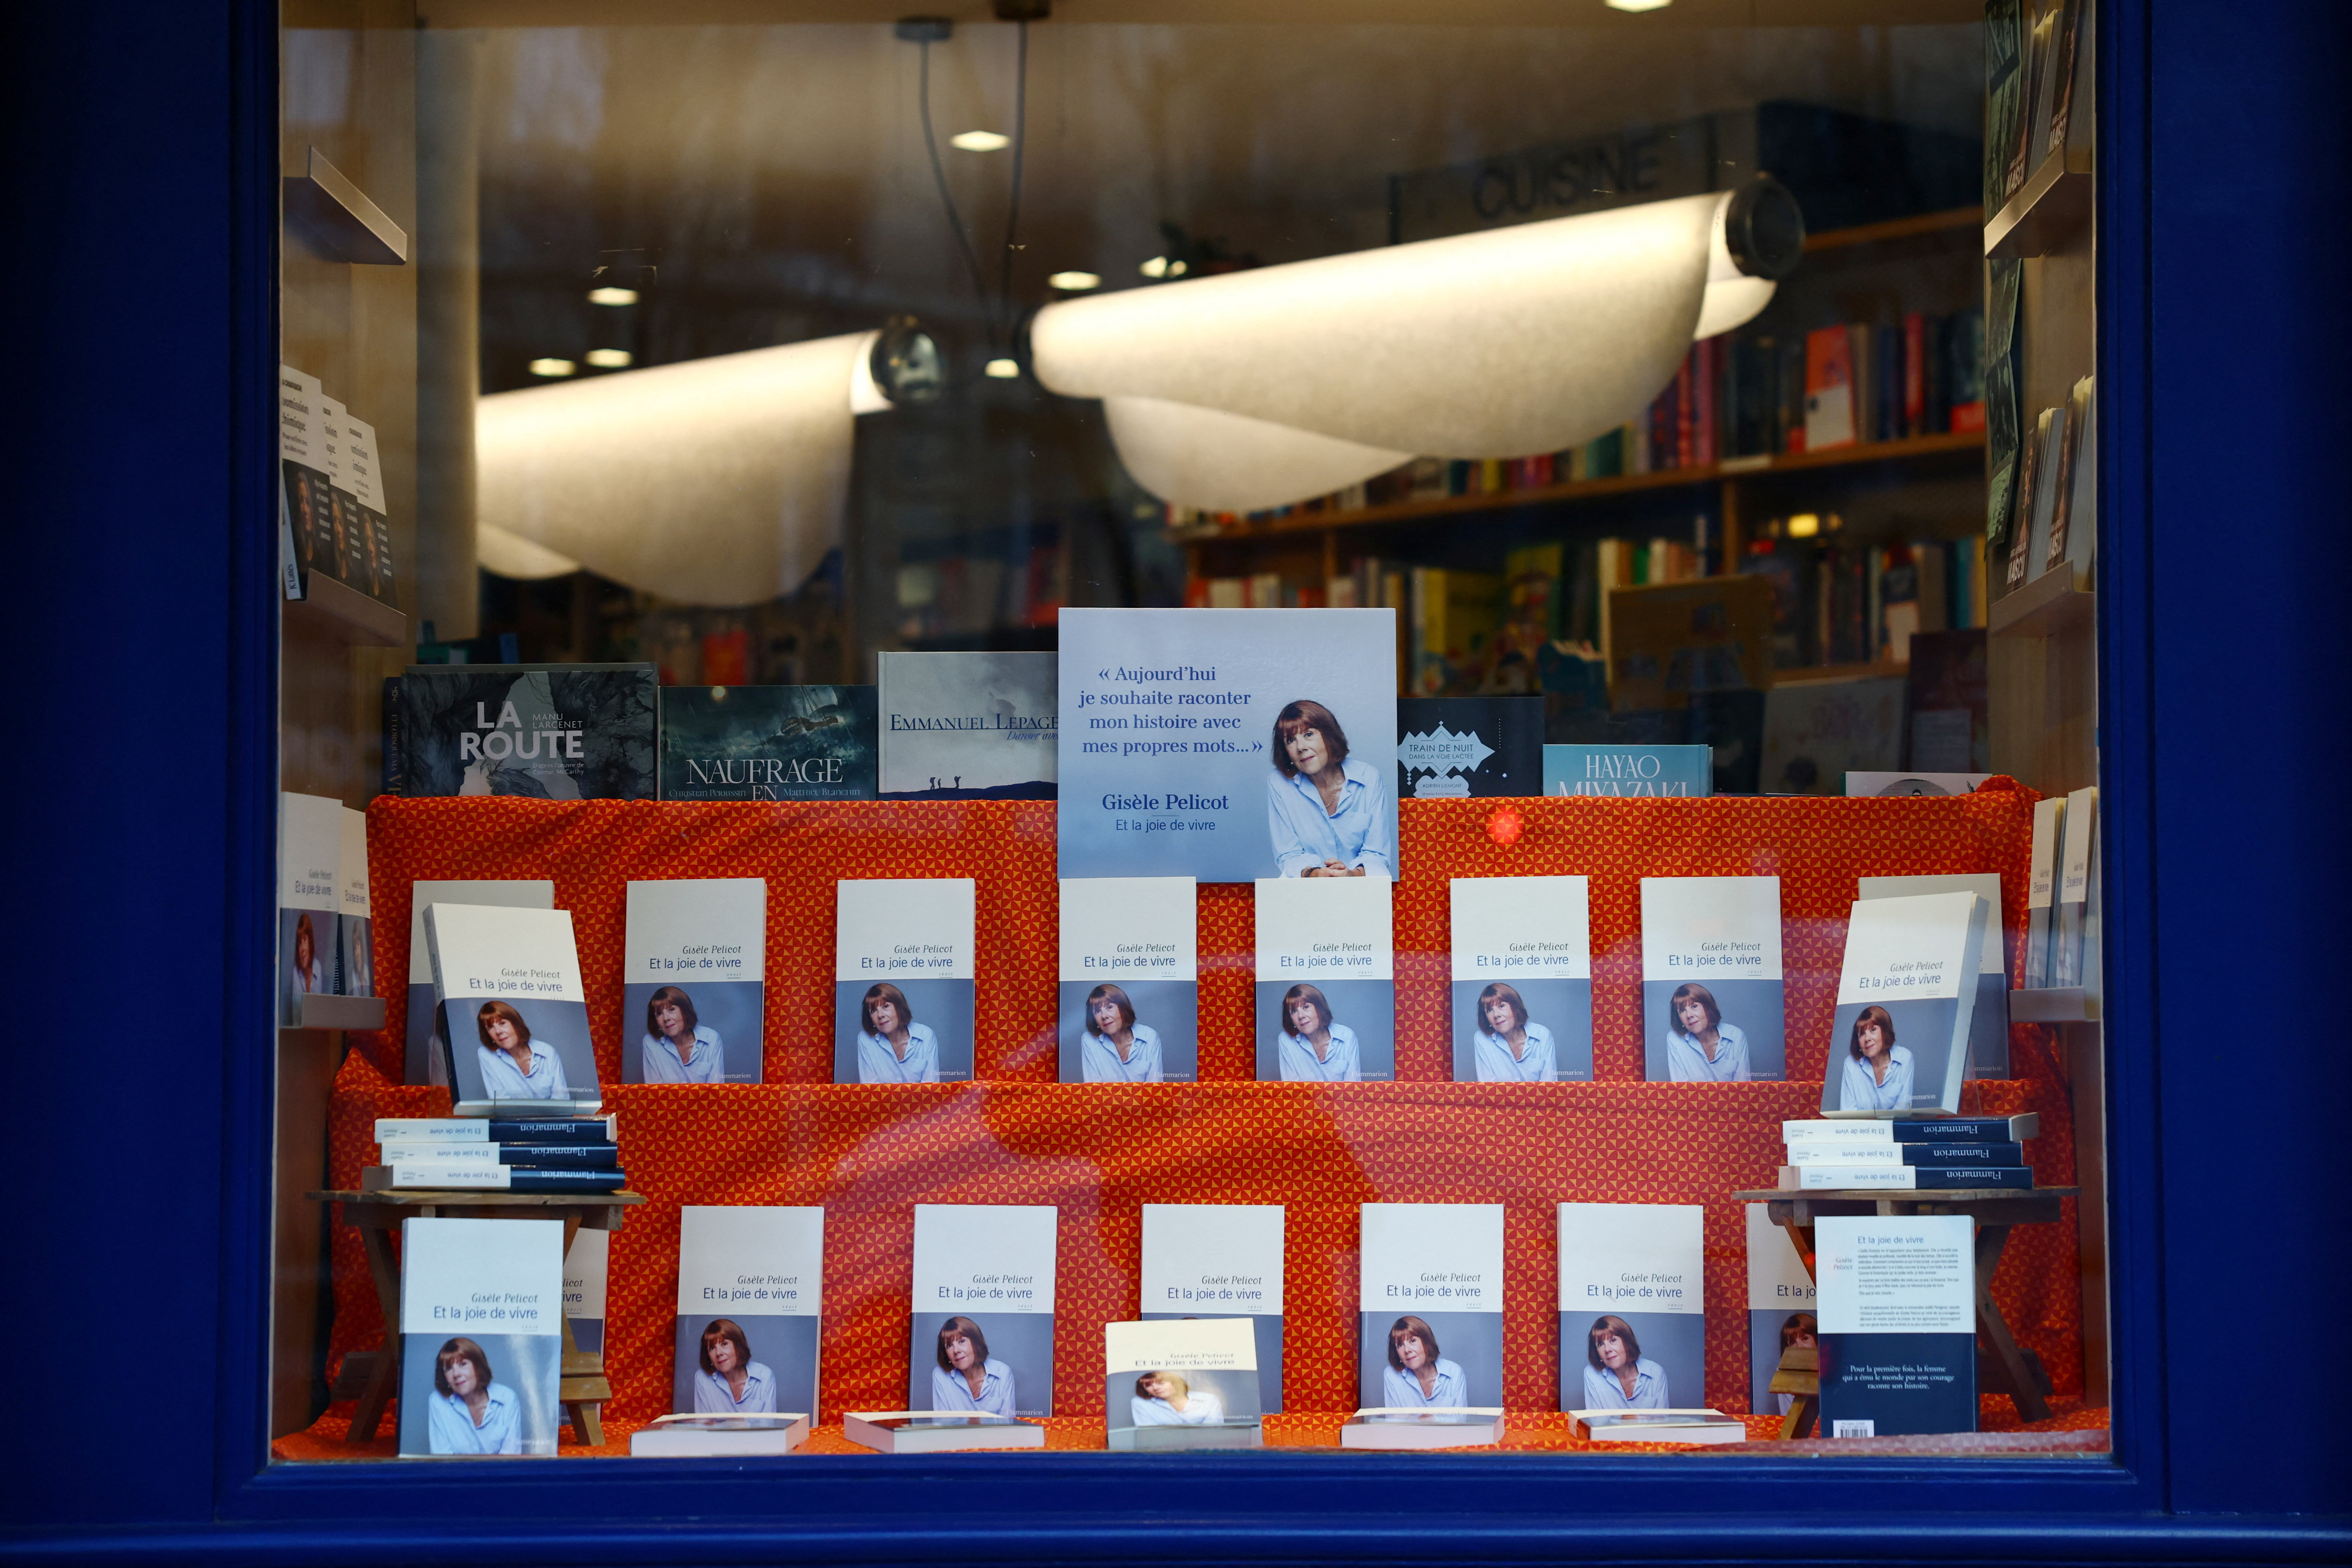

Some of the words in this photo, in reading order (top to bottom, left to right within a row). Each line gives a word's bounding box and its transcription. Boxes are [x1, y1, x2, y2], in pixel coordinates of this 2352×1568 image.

[1114, 666, 1216, 684] Aujourd’hui
[1078, 690, 1095, 708] je
[1100, 690, 1173, 705] souhaite
[1178, 691, 1251, 705] raconter
[477, 700, 523, 728] LA
[891, 714, 989, 729] EMMANUEL
[996, 712, 1058, 729] LEPAGE
[533, 721, 583, 729] LARCENET
[1090, 718, 1129, 729] mon
[1133, 714, 1197, 728] histoire
[1203, 718, 1241, 728] avec
[1006, 731, 1041, 741] Danser
[461, 730, 584, 760] ROUTE
[1083, 742, 1118, 753] mes
[1123, 742, 1188, 756] propres
[686, 758, 843, 784] NAUFRAGE
[1586, 755, 1660, 778] HAYAO
[752, 785, 778, 801] EN
[1102, 794, 1159, 810] Gisèle
[1165, 794, 1229, 810] Pelicot
[1116, 819, 1128, 831] Et
[1132, 819, 1141, 831] la
[1145, 819, 1166, 833] joie
[1170, 819, 1184, 831] de
[1188, 819, 1216, 831] vivre
[682, 945, 709, 954] Gisèle
[711, 945, 742, 954] Pelicot
[894, 945, 920, 954] Gisèle
[923, 945, 953, 953] Pelicot
[1117, 944, 1143, 952] Gisèle
[1146, 943, 1176, 952] Pelicot
[1510, 943, 1535, 952] Gisèle
[1538, 943, 1568, 951] Pelicot
[1701, 943, 1728, 951] Gisèle
[1731, 942, 1761, 951] Pelicot
[650, 958, 661, 969] Et
[664, 958, 673, 968] la
[676, 957, 696, 971] joie
[699, 957, 713, 968] de
[716, 957, 741, 968] vivre
[862, 957, 873, 968] Et
[876, 957, 885, 968] la
[888, 957, 908, 970] joie
[911, 957, 924, 967] de
[928, 957, 953, 967] vivre
[1085, 957, 1096, 967] Et
[1099, 956, 1108, 967] la
[1111, 956, 1130, 969] joie
[1134, 956, 1147, 966] de
[1150, 955, 1176, 966] vivre
[1477, 955, 1488, 966] Et
[1492, 955, 1500, 966] la
[1504, 955, 1523, 968] joie
[1527, 954, 1540, 965] de
[1543, 954, 1568, 965] vivre
[1669, 955, 1680, 966] Et
[1684, 955, 1693, 965] la
[1696, 954, 1715, 968] joie
[1719, 954, 1733, 965] de
[1736, 954, 1761, 965] vivre
[1890, 962, 1914, 972] Gisèle
[1916, 961, 1944, 971] Pelicot
[501, 968, 527, 977] Gisèle
[531, 969, 560, 978] Pelicot
[469, 978, 482, 989] Et
[484, 979, 495, 989] la
[498, 979, 518, 992] joie
[520, 980, 534, 991] de
[537, 981, 562, 992] vivre
[1859, 977, 1870, 988] Et
[1872, 977, 1881, 987] la
[1882, 975, 1900, 989] joie
[1903, 974, 1916, 985] de
[1918, 973, 1941, 985] vivre
[520, 1124, 576, 1132] Flammarion
[1923, 1125, 1978, 1134] Flammarion
[530, 1147, 588, 1155] Flammarion
[1933, 1149, 1989, 1158] Flammarion
[1946, 1171, 2001, 1179] Flammarion
[973, 1274, 999, 1283] Gisèle
[1002, 1275, 1032, 1283] Pelicot
[1421, 1273, 1447, 1282] Gisèle
[1450, 1273, 1480, 1282] Pelicot
[471, 1293, 501, 1303] Gisèle
[504, 1293, 537, 1303] Pelicot
[939, 1286, 950, 1298] Et
[954, 1287, 963, 1298] la
[966, 1287, 986, 1300] joie
[989, 1287, 1003, 1298] de
[1007, 1287, 1032, 1298] vivre
[1387, 1285, 1398, 1296] Et
[1402, 1285, 1411, 1296] la
[1415, 1285, 1435, 1299] joie
[1438, 1286, 1451, 1297] de
[1455, 1286, 1481, 1297] vivre
[434, 1306, 446, 1319] Et
[450, 1307, 461, 1319] la
[465, 1306, 487, 1322] joie
[490, 1307, 505, 1319] de
[509, 1307, 538, 1319] vivre
[1874, 1365, 1901, 1374] première
